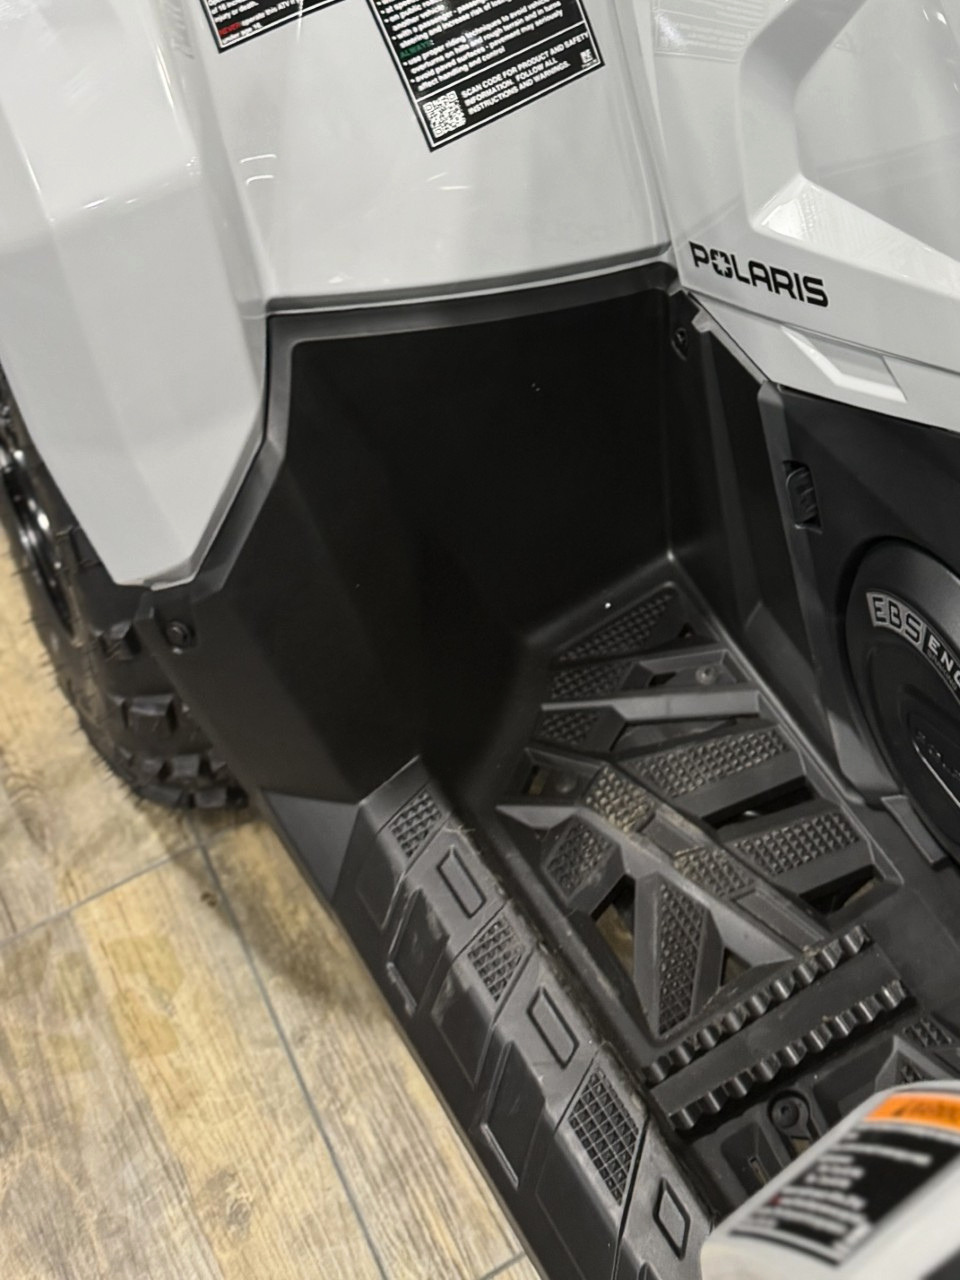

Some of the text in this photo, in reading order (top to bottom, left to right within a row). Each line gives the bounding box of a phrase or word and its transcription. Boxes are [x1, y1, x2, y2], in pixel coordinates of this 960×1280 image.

[460, 31, 589, 98] SCAN CODE FOR PRODUCT AND SAFETY
[515, 62, 544, 82] FOLLOW
[543, 56, 557, 68] ALL
[467, 85, 519, 115] INSTRUCTIONS
[517, 77, 534, 90] AND
[689, 241, 828, 307] POLARIS
[872, 596, 921, 643] EBS
